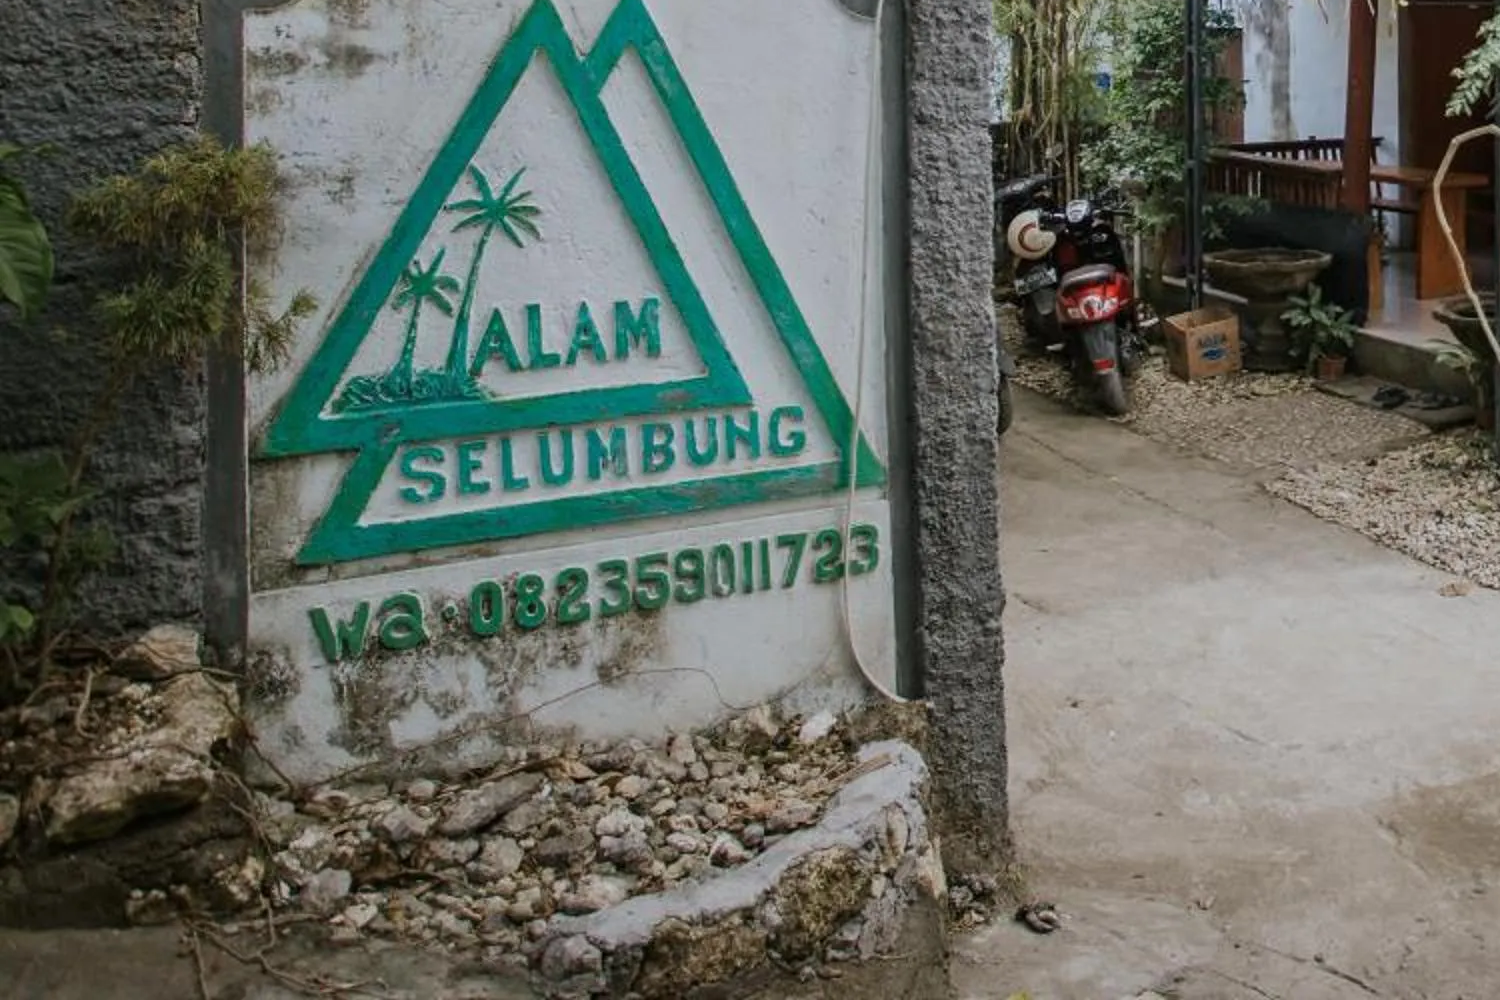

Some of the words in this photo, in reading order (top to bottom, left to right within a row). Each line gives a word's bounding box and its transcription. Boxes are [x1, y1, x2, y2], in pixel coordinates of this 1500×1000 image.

[471, 297, 662, 374] ALAM
[401, 406, 808, 503] SELUMBUNG
[470, 523, 880, 637] 082359011723
